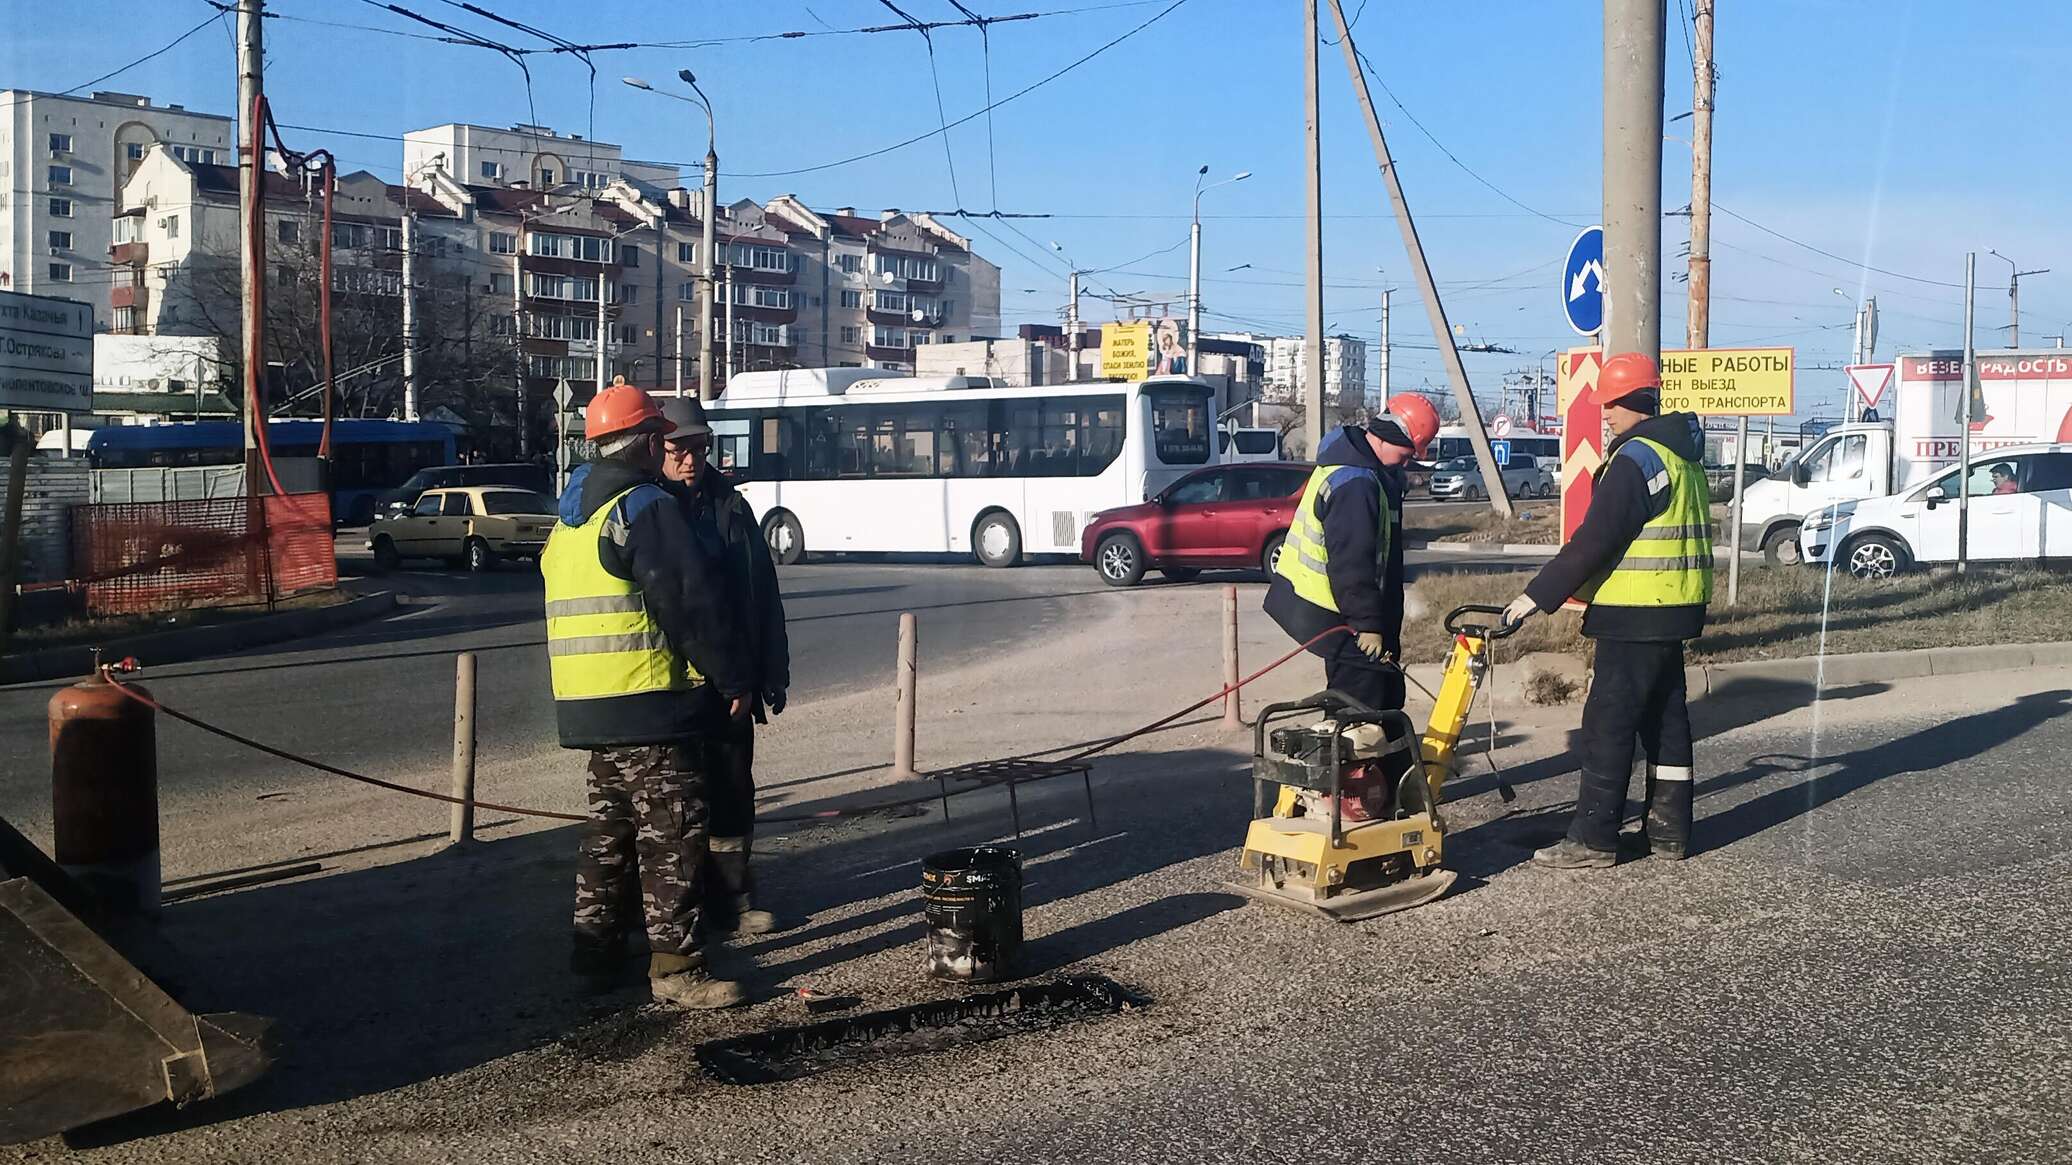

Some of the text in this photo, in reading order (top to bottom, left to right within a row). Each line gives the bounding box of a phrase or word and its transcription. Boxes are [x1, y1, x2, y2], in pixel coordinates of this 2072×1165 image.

[1712, 356, 1788, 372] РАБОТЫ
[1916, 358, 2068, 376] ВЕЗЕ РАДОСТЬ
[1691, 378, 1736, 391] ВЫЕЗД
[1699, 396, 1786, 408] ТРАНСПОРТА
